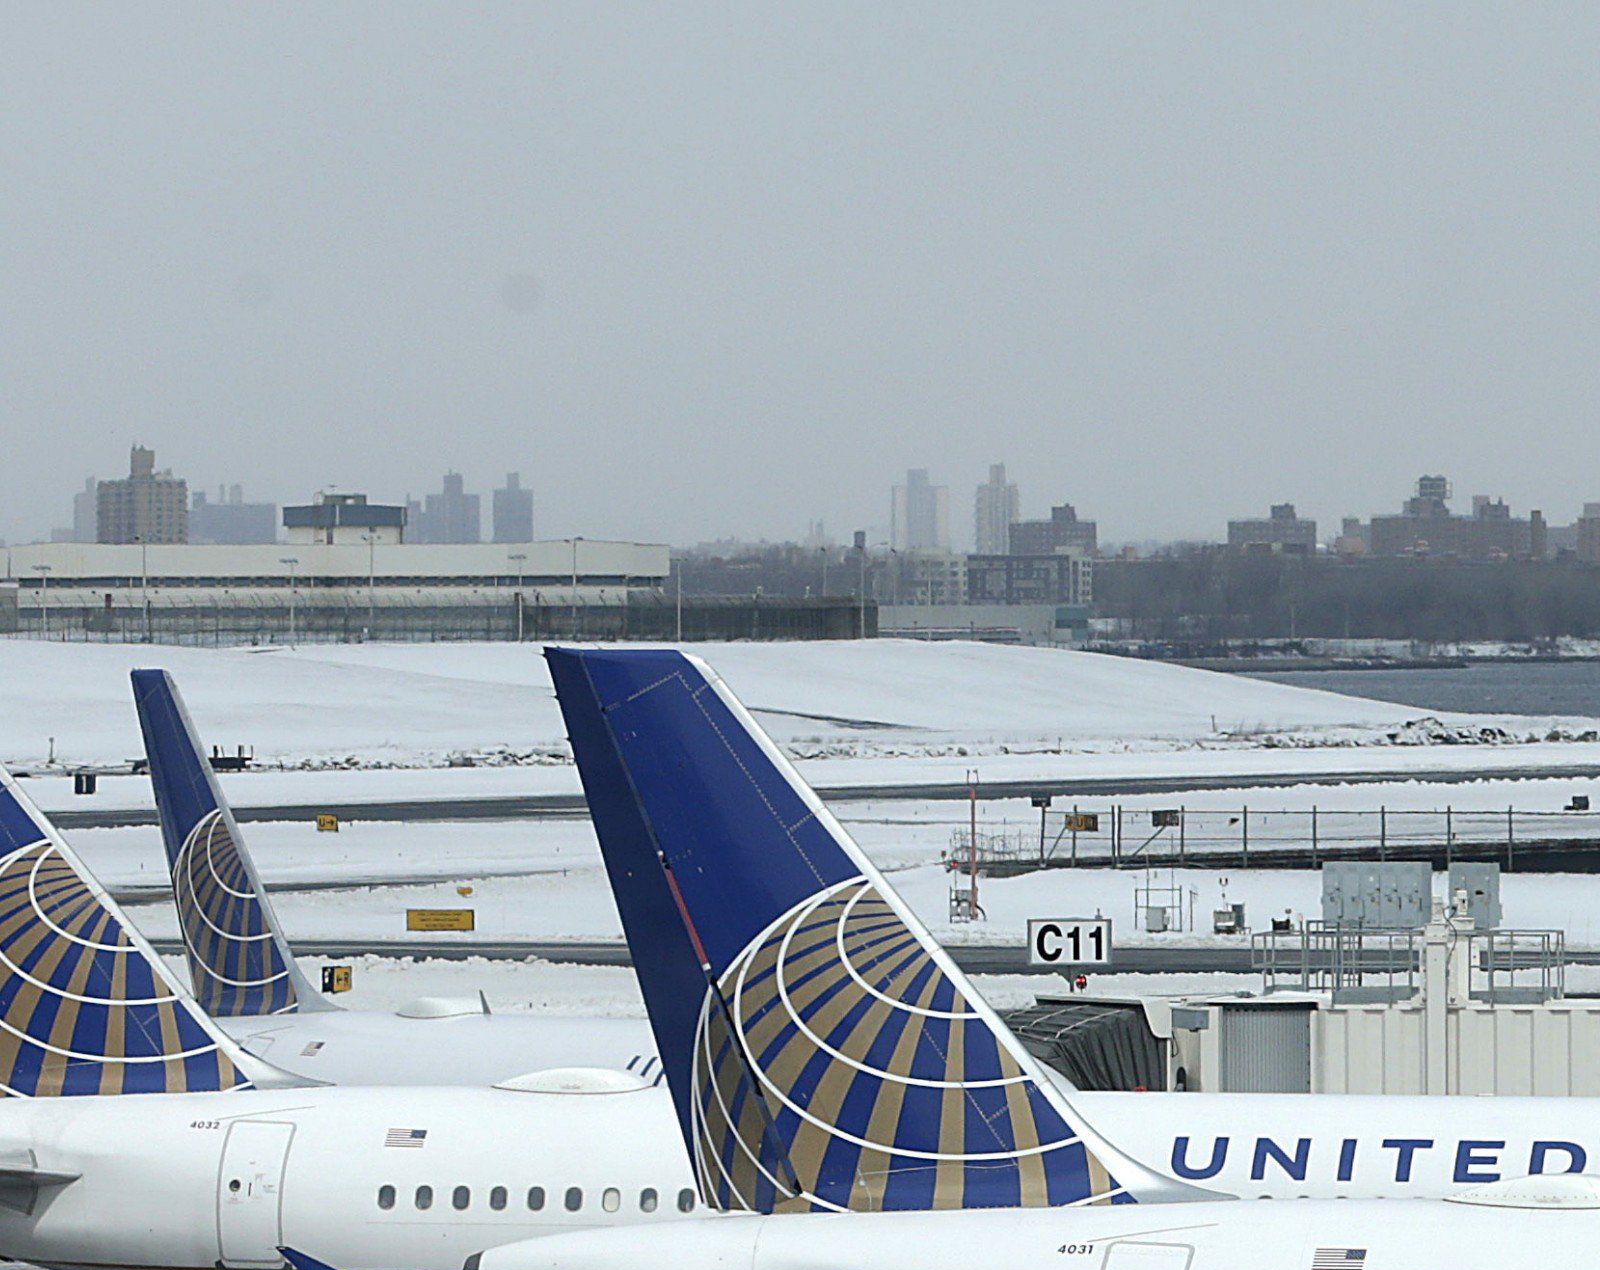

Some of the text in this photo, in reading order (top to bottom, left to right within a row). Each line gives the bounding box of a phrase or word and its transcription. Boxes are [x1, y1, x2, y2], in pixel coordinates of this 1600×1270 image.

[1037, 924, 1102, 962] C11
[190, 1120, 220, 1130] 4032
[1170, 1136, 1588, 1183] UNITED
[1057, 1244, 1093, 1254] 4031
